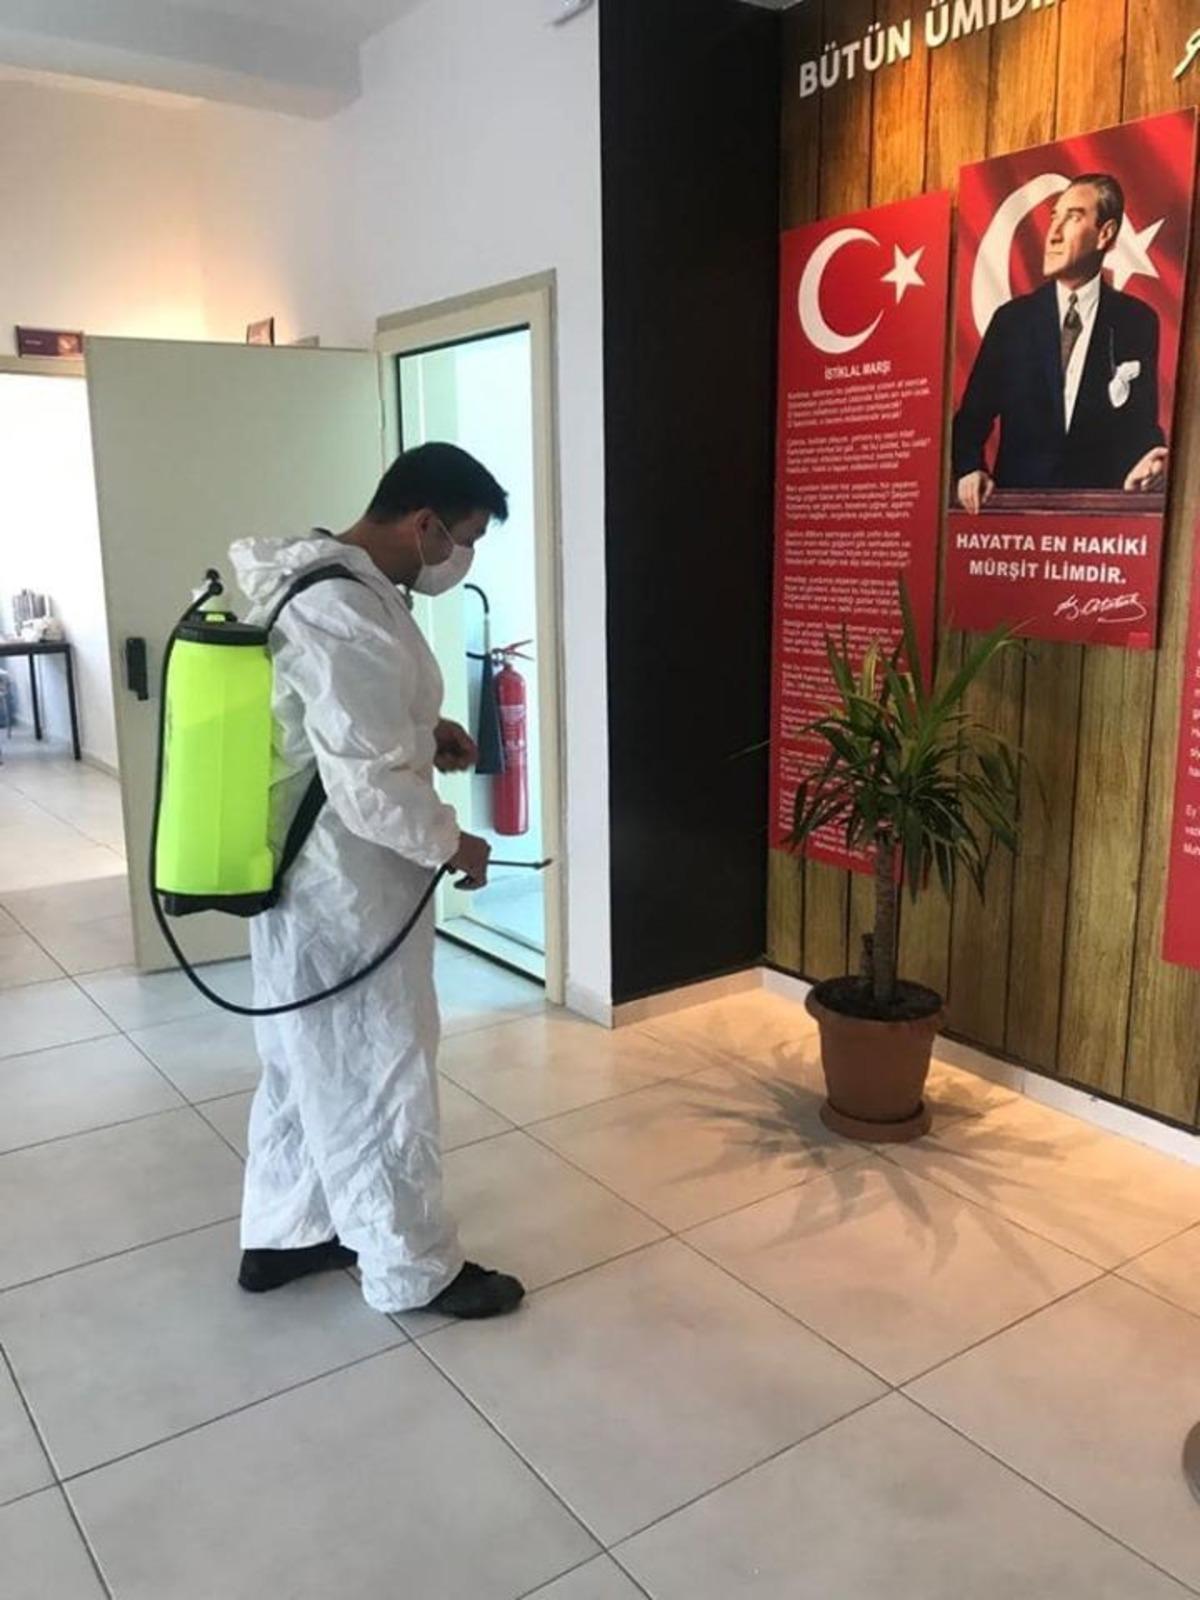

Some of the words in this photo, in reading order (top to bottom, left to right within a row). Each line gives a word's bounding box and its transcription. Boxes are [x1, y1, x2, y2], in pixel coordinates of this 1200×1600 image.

[800, 18, 911, 98] BÜTÜN
[956, 533, 1035, 551] HAYATTA
[1041, 535, 1066, 552] EN
[1073, 534, 1147, 556] HAKİKİ
[969, 558, 1039, 581] MÜRŞİT
[1044, 559, 1126, 584] İLİMDİR.
